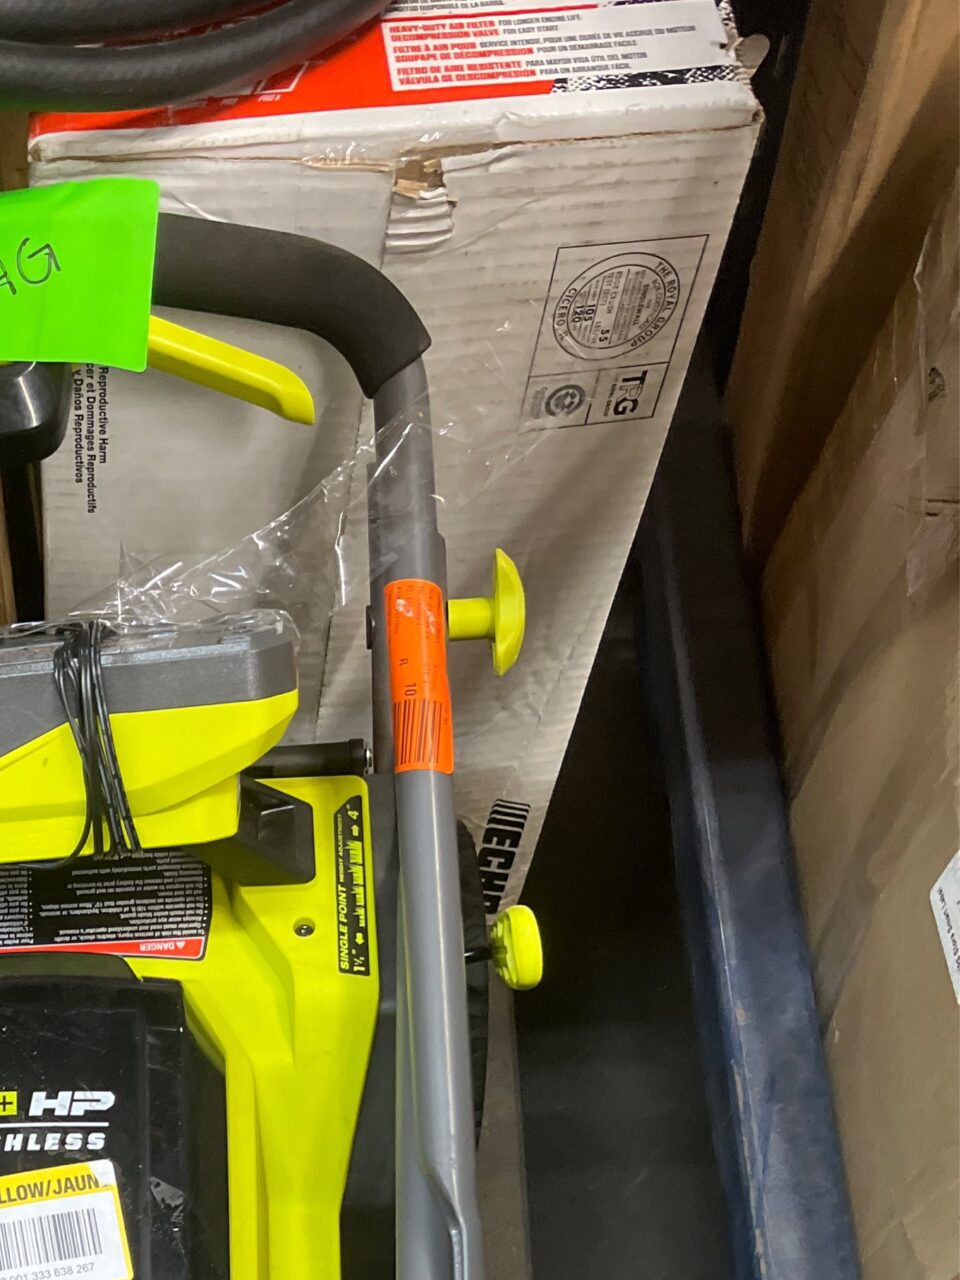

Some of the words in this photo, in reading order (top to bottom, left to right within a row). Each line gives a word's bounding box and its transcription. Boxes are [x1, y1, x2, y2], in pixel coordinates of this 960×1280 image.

[390, 24, 446, 33] HEAVY-DUTY
[449, 22, 464, 30] AIR
[467, 20, 495, 29] FILTER
[391, 31, 470, 42] DECOMPRESSION
[472, 29, 499, 37] VALVE
[393, 45, 421, 54] FILTRE
[433, 43, 449, 51] AIR
[451, 42, 477, 51] POUR
[655, 261, 672, 282] THE
[556, 287, 577, 327] CICERO
[663, 279, 678, 312] ROYAL
[630, 316, 666, 348] GROUP
[73, 379, 84, 412] Daños
[86, 382, 96, 393] et
[98, 366, 110, 436] Reproductive
[613, 369, 648, 416] TRG
[85, 395, 96, 452] Dommages
[73, 414, 84, 484] Reproductivos
[98, 438, 109, 464] Harm
[85, 454, 97, 514] Reproductifs
[337, 883, 348, 923] POINT
[139, 942, 175, 951] DANGER
[339, 923, 350, 971] SINGLE
[28, 1091, 116, 1117] HP
[53, 1265, 74, 1279] 638
[76, 1262, 95, 1275] 267
